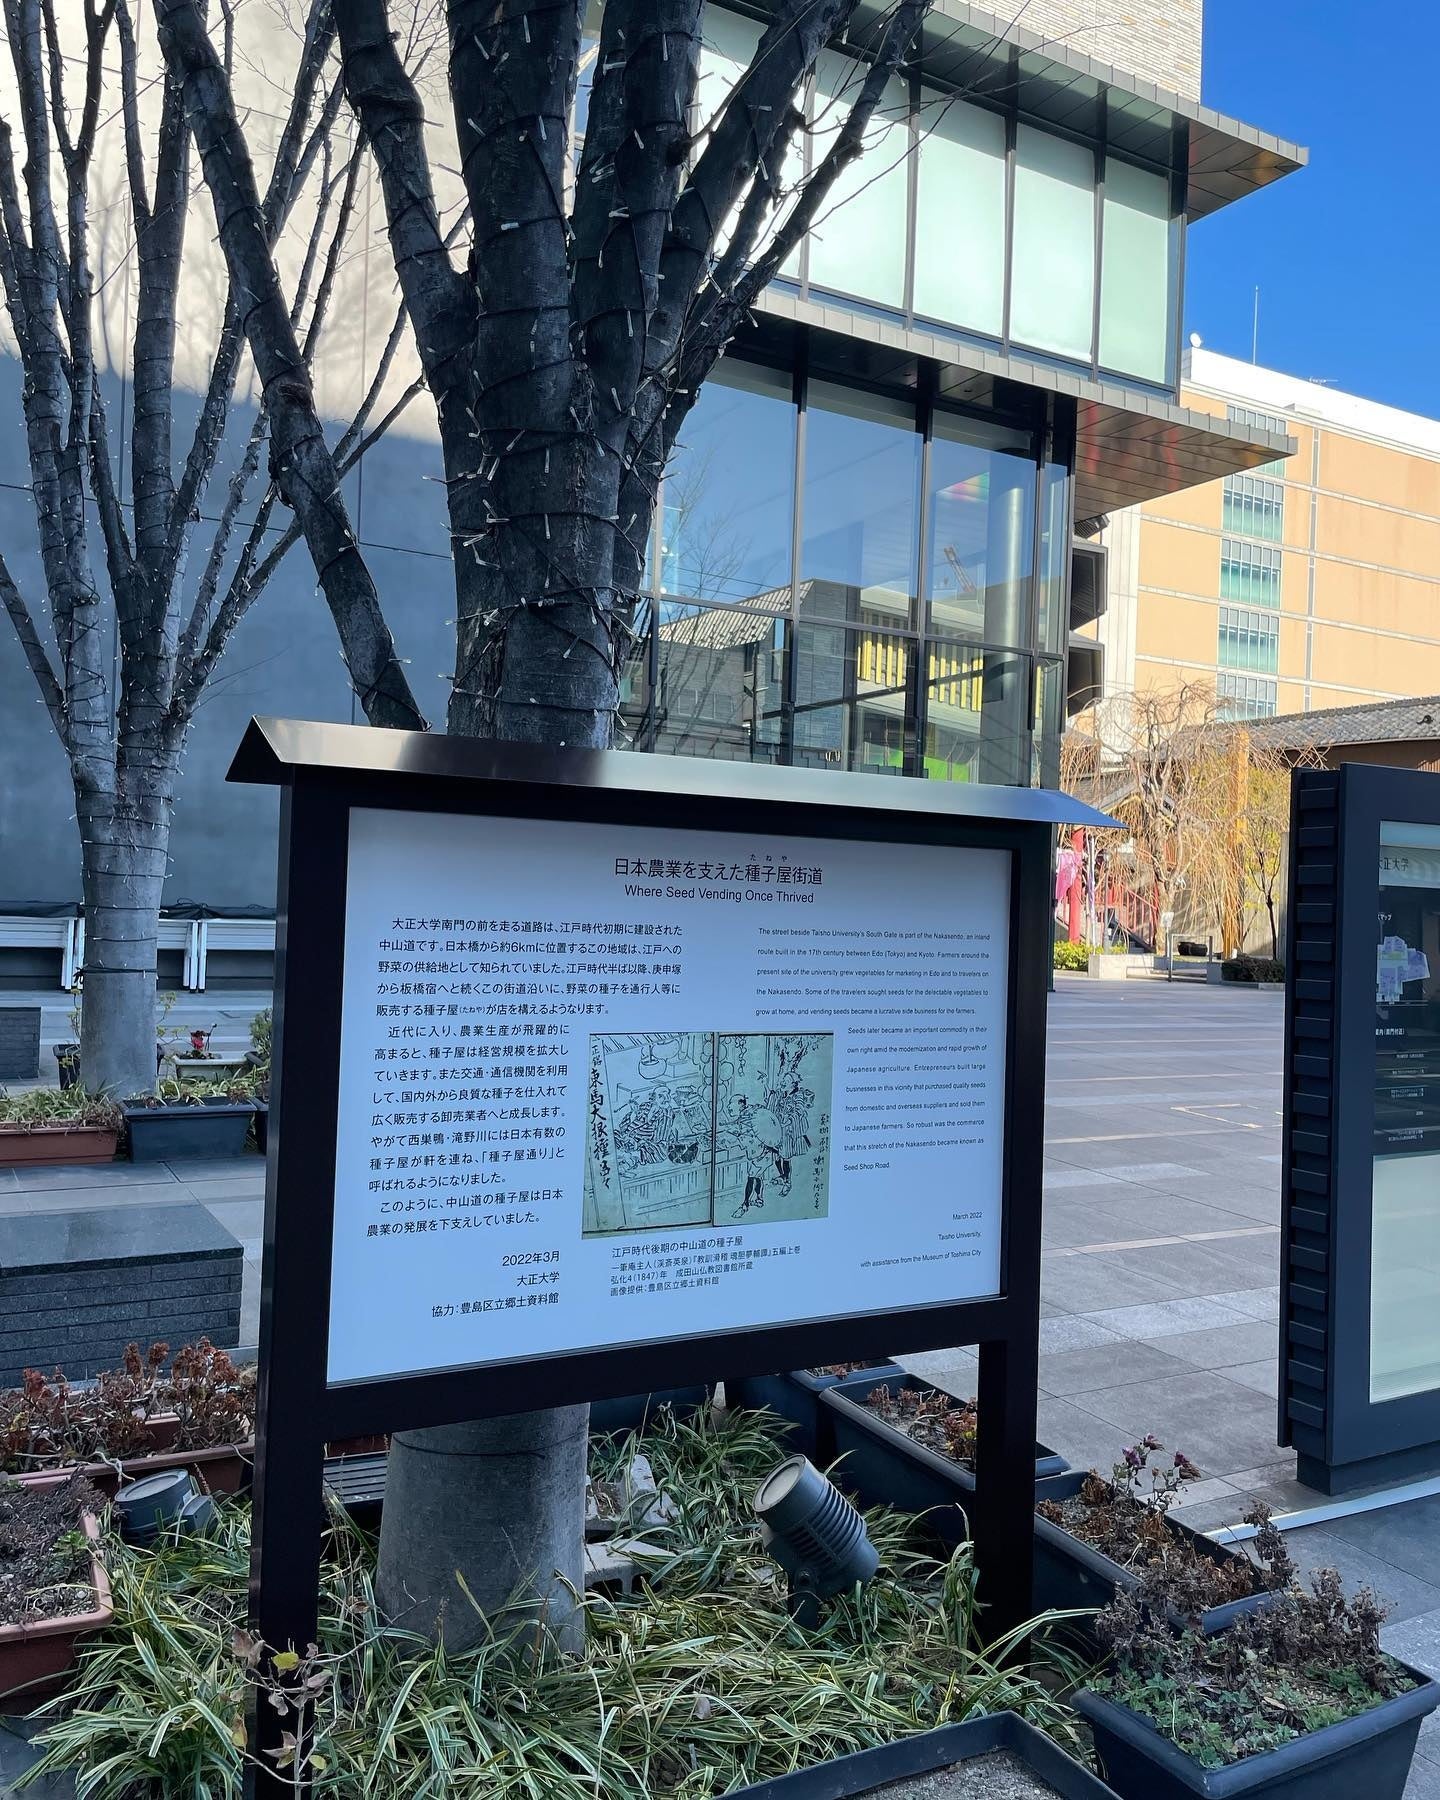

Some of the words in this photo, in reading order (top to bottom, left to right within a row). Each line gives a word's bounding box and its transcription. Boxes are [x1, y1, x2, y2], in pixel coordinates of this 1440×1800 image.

[615, 858, 823, 885] 日本農業を支えた種子屋街道
[624, 885, 662, 898] Where
[666, 886, 695, 899] Seed
[698, 888, 742, 903] Vending
[745, 890, 773, 902] Once
[778, 891, 814, 903] Thrived
[392, 918, 683, 936] 大正大学南門の前を走る道路は、江戸時代初期に建設された
[379, 939, 682, 956] 中山道です。日本橋から約6kmに位置するこの地域は、江戸への
[378, 961, 682, 976] 野菜の供給地として知られていました。江戸時代半ば以降、庚申塚
[377, 982, 681, 995] から板橋宿へと続くこの街道沿いに、野菜の種子を通行人等に
[388, 1024, 570, 1039] 近代に入り、農業生産が飛躍的に
[374, 1045, 569, 1061] 高まると、種子屋は経営規模を拡大し
[374, 1065, 568, 1082] ていきます。また交通・通信機関を利用
[373, 1085, 567, 1104] して、国内外から良質な種子を仕入れて
[371, 1106, 565, 1126] 広く販売する卸売業者へと成長します。
[371, 1127, 566, 1148] やがて西巣鴨・滝野川には日本有数の
[369, 1147, 565, 1170] 種子屋が軒を連ね、「種子屋通り」と
[368, 1172, 506, 1193] 呼ばれるようになりました。
[380, 1188, 563, 1213] このように、中山道の種子屋は日本
[366, 1211, 540, 1237] 農業の発展を下支えしていました。
[612, 1235, 743, 1259] 江戸時代後期の中山道の種子屋
[502, 1250, 560, 1266] 2022年3月
[517, 1271, 560, 1286] 大正大学
